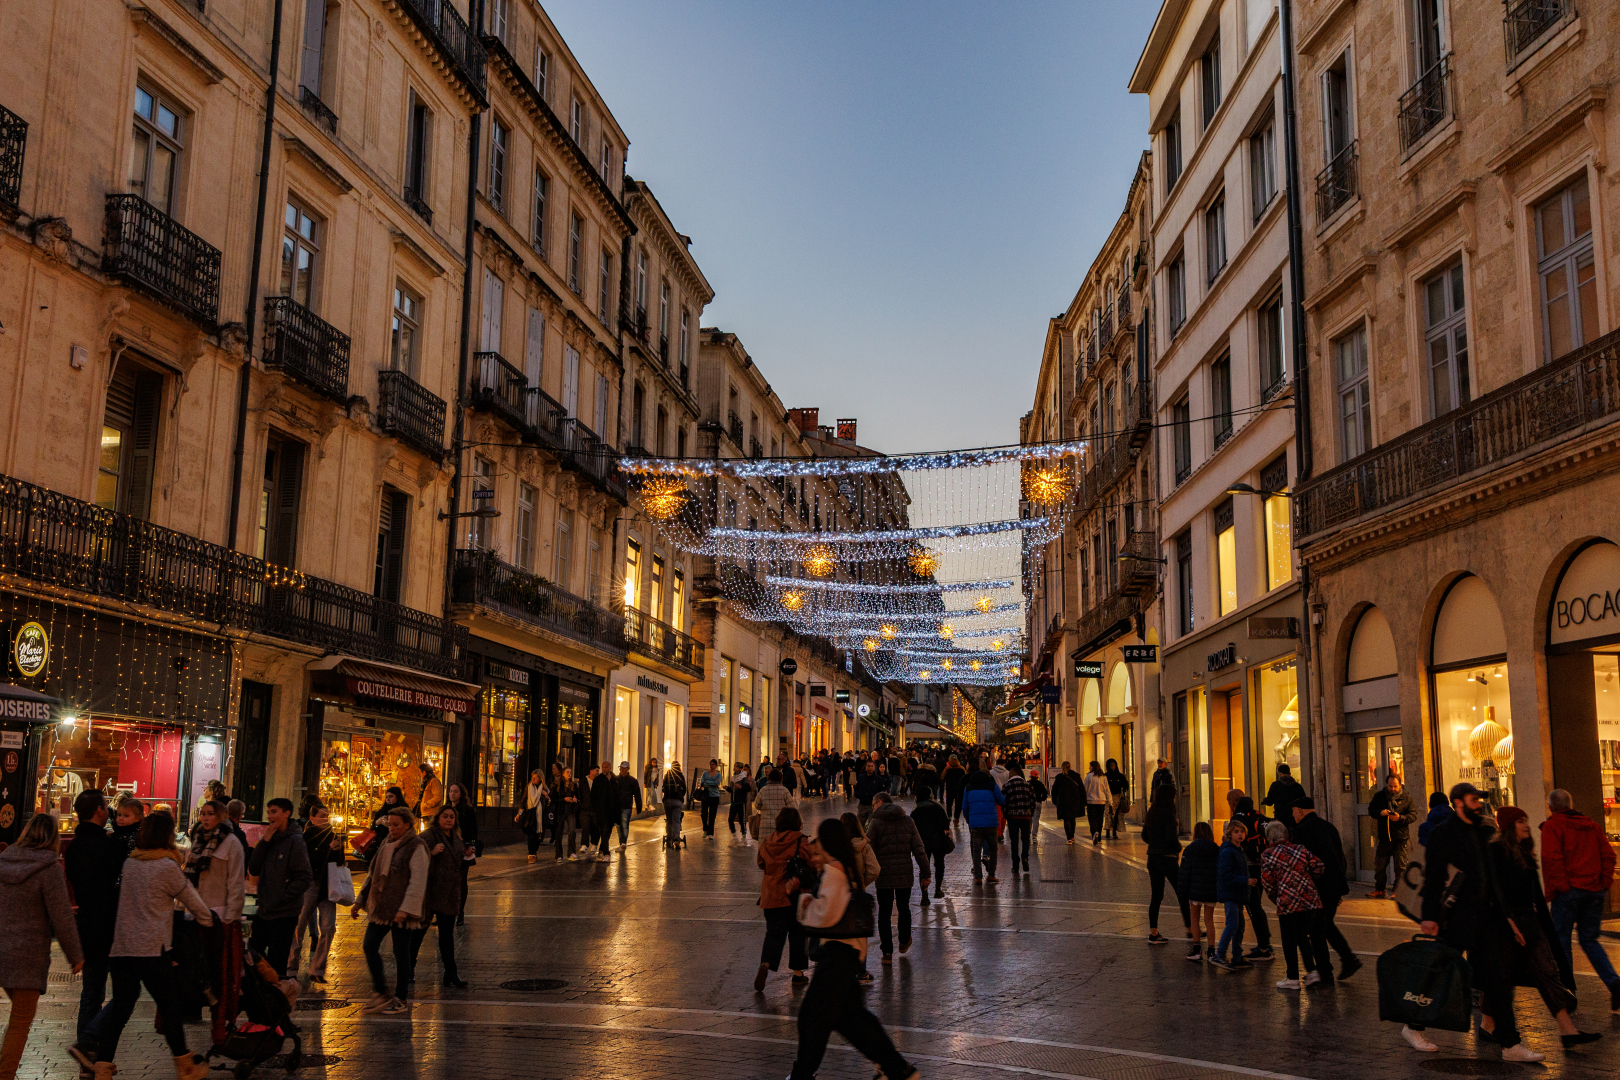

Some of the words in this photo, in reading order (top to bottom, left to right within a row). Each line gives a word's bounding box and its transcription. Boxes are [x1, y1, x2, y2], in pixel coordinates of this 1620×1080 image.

[18, 642, 43, 655] Marie
[358, 680, 412, 703] COUTELLERIE
[416, 692, 443, 709] PRADEL
[444, 698, 467, 713] GOLEO
